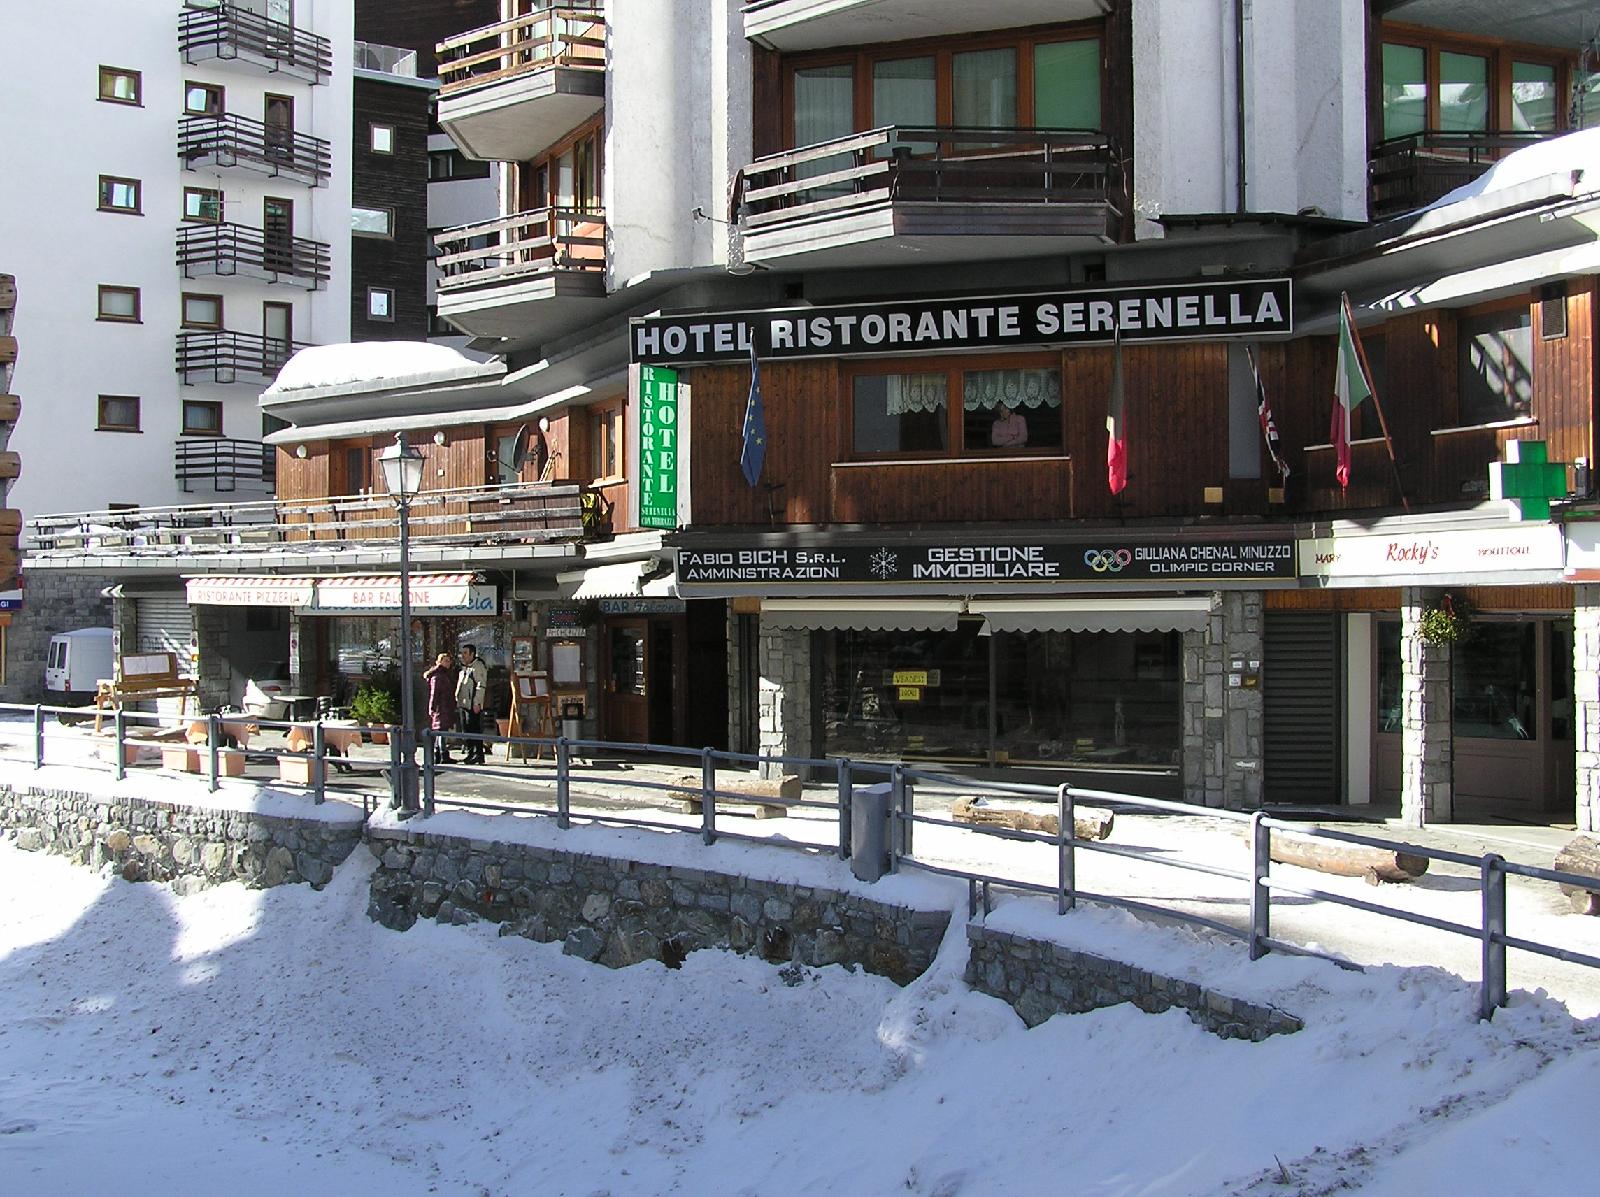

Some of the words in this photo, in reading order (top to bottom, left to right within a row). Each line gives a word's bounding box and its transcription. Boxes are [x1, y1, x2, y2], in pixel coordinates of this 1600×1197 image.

[637, 322, 753, 355] HOTEL
[771, 306, 1021, 348] RISTORANTE
[1036, 292, 1283, 334] SERENELLA
[642, 367, 655, 506] RISTORANTE
[658, 382, 676, 493] HOTEL
[679, 551, 733, 565] FABIO
[739, 550, 787, 565] BICH
[796, 552, 846, 564] S.R.L.
[928, 546, 1044, 562] GESTIONE
[1135, 546, 1188, 561] GIULIANA
[1190, 546, 1237, 560] CHENAL
[1239, 545, 1291, 559] MINUZZO
[1386, 540, 1439, 564] Rocky's
[686, 567, 839, 580] AMMINISTRAZIONI
[912, 562, 1060, 578] IMMOBILIARE
[1149, 562, 1208, 573] OLIMPIC
[1211, 561, 1275, 572] CORNER
[197, 590, 252, 603] RISTORANTE
[256, 591, 301, 603] PIZZERIA
[353, 591, 374, 604] BAR
[602, 600, 630, 613] BAR
